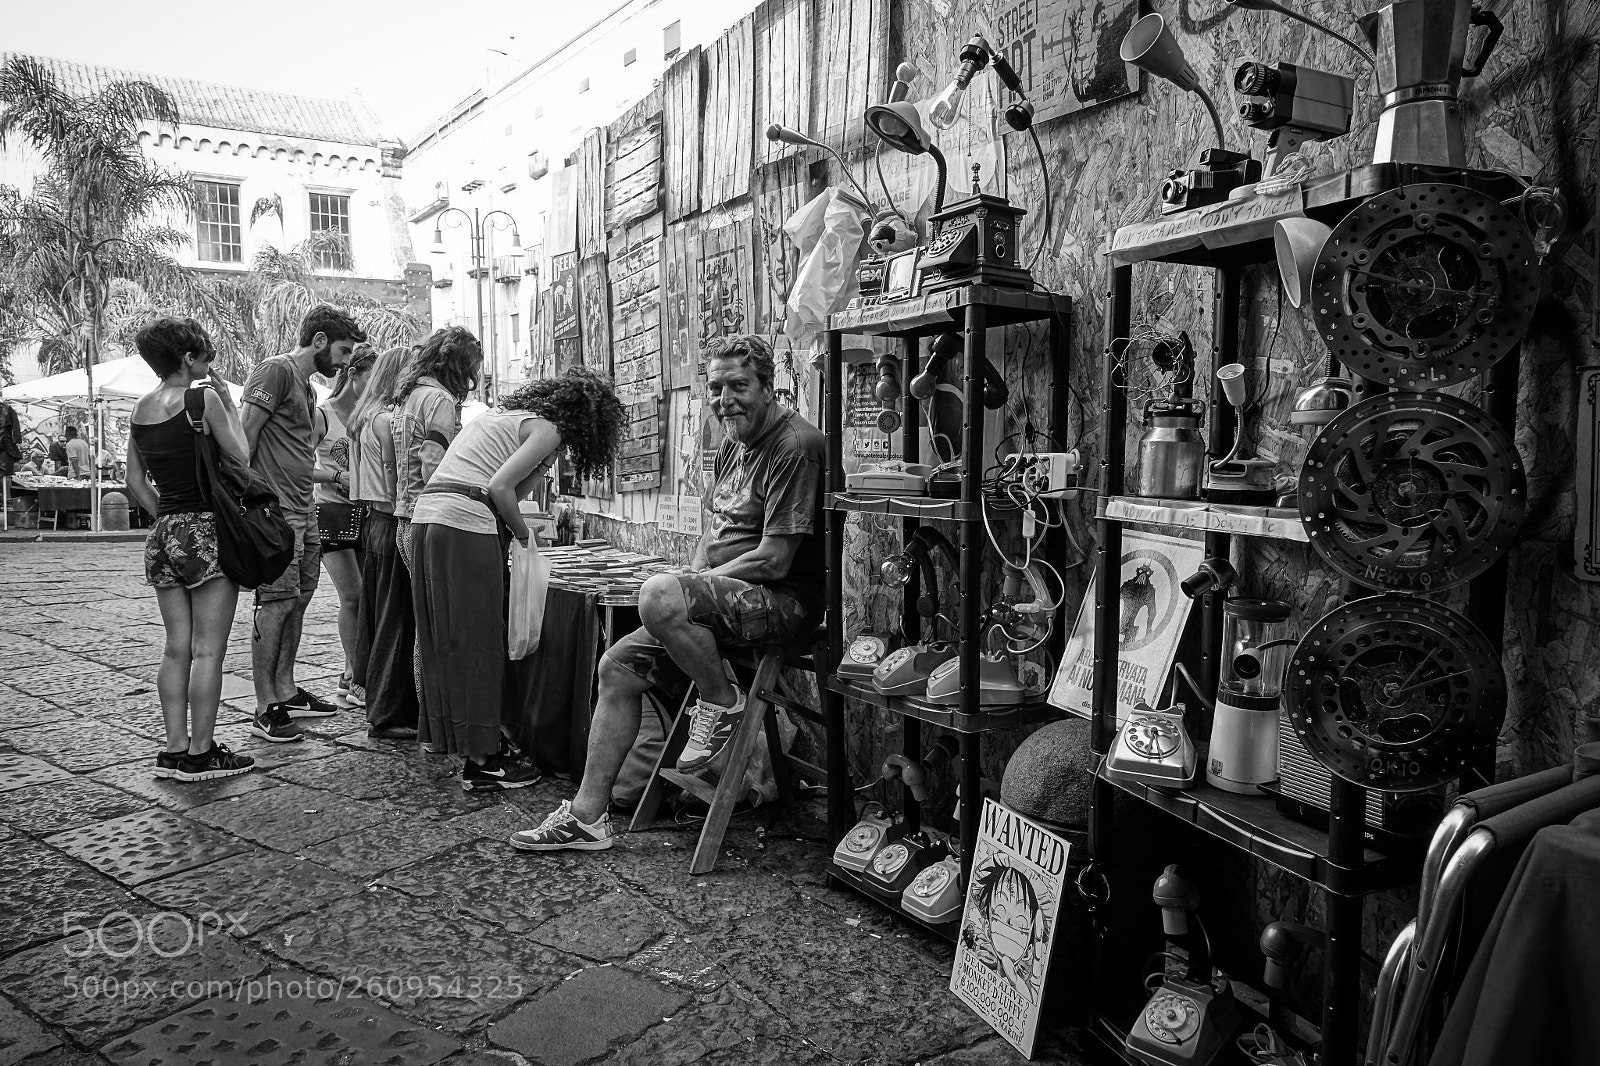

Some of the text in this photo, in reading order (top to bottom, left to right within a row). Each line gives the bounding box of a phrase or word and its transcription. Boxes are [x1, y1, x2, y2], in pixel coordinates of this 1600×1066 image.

[998, 0, 1038, 49] STREET
[1365, 564, 1459, 586] NEW YOK
[984, 799, 1065, 876] WANTED
